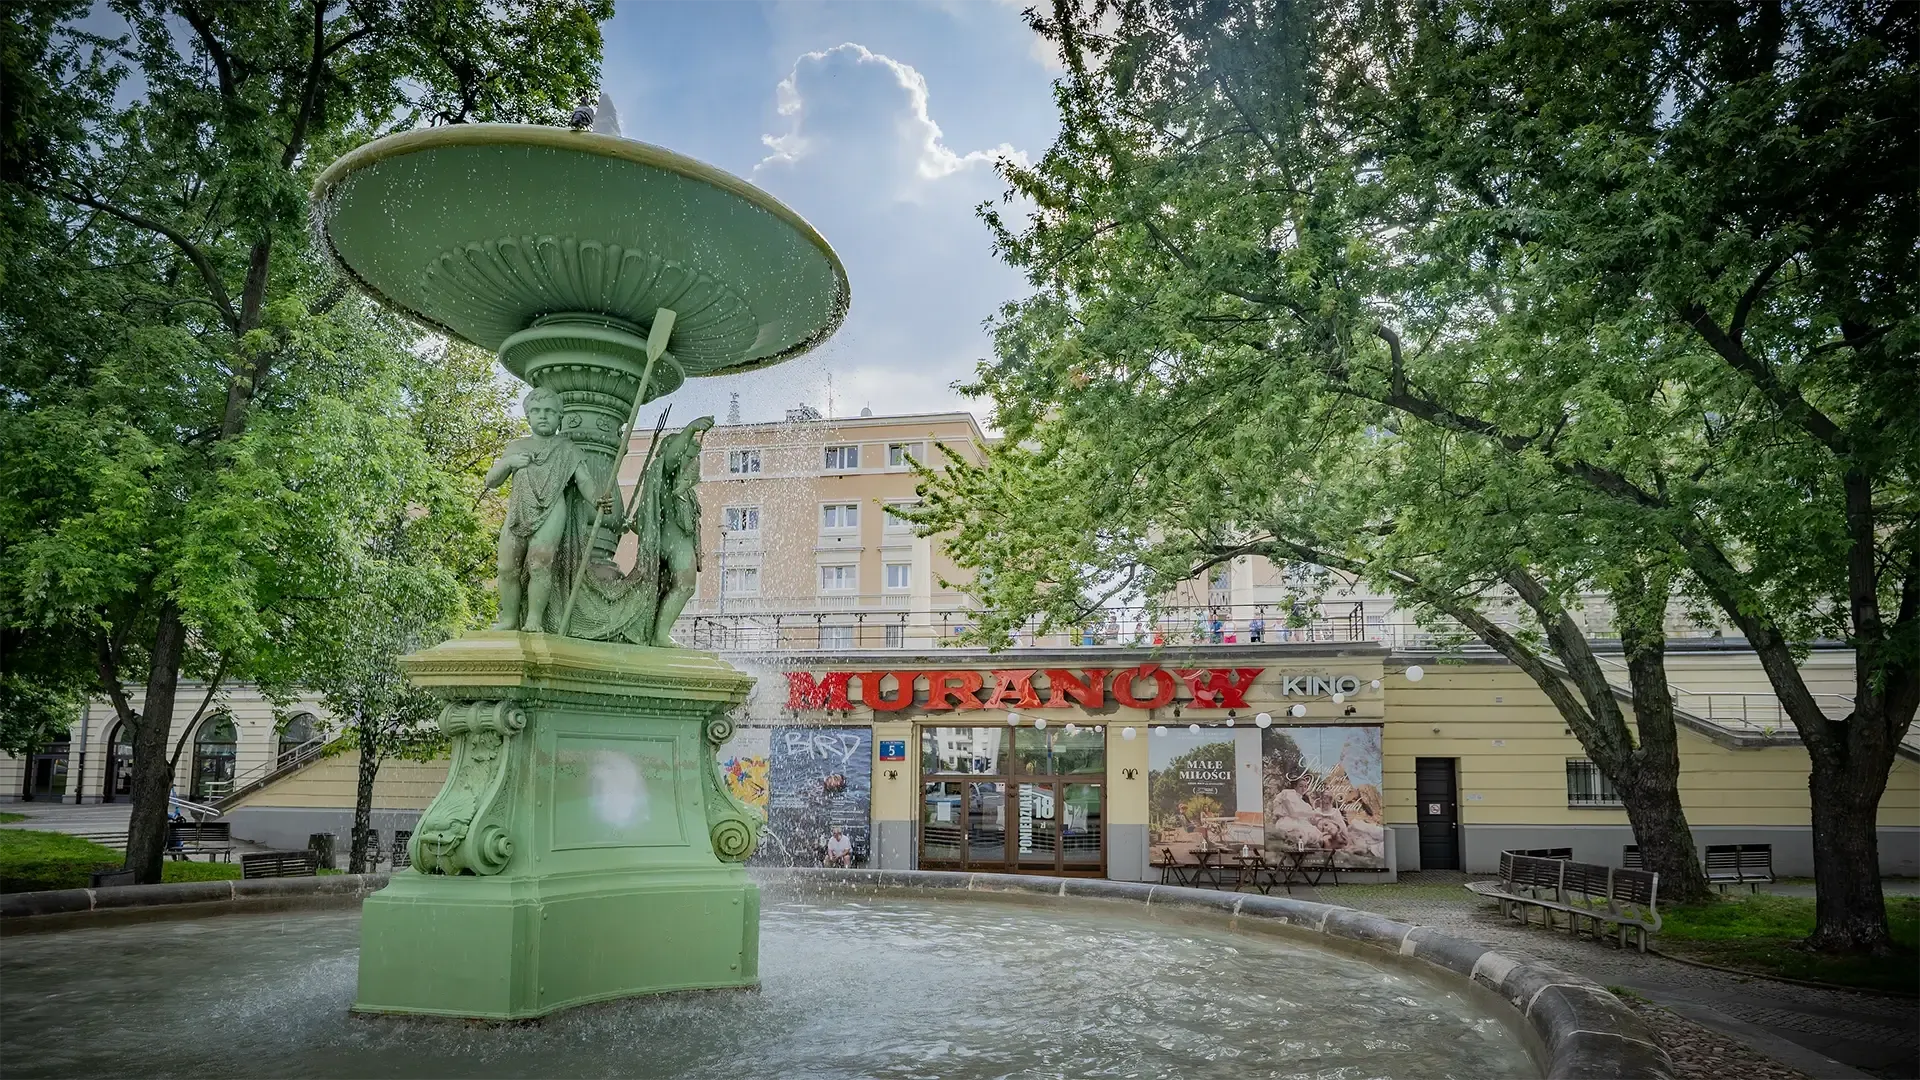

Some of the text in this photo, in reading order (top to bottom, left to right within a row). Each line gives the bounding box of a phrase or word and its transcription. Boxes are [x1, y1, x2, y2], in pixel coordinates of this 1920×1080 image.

[1282, 675, 1361, 697] KINO
[784, 731, 862, 763] BIRD
[888, 745, 896, 756] 5
[1187, 760, 1223, 769] MAŁE
[1179, 768, 1231, 780] MIŁOŚCI
[1033, 797, 1054, 819] 18
